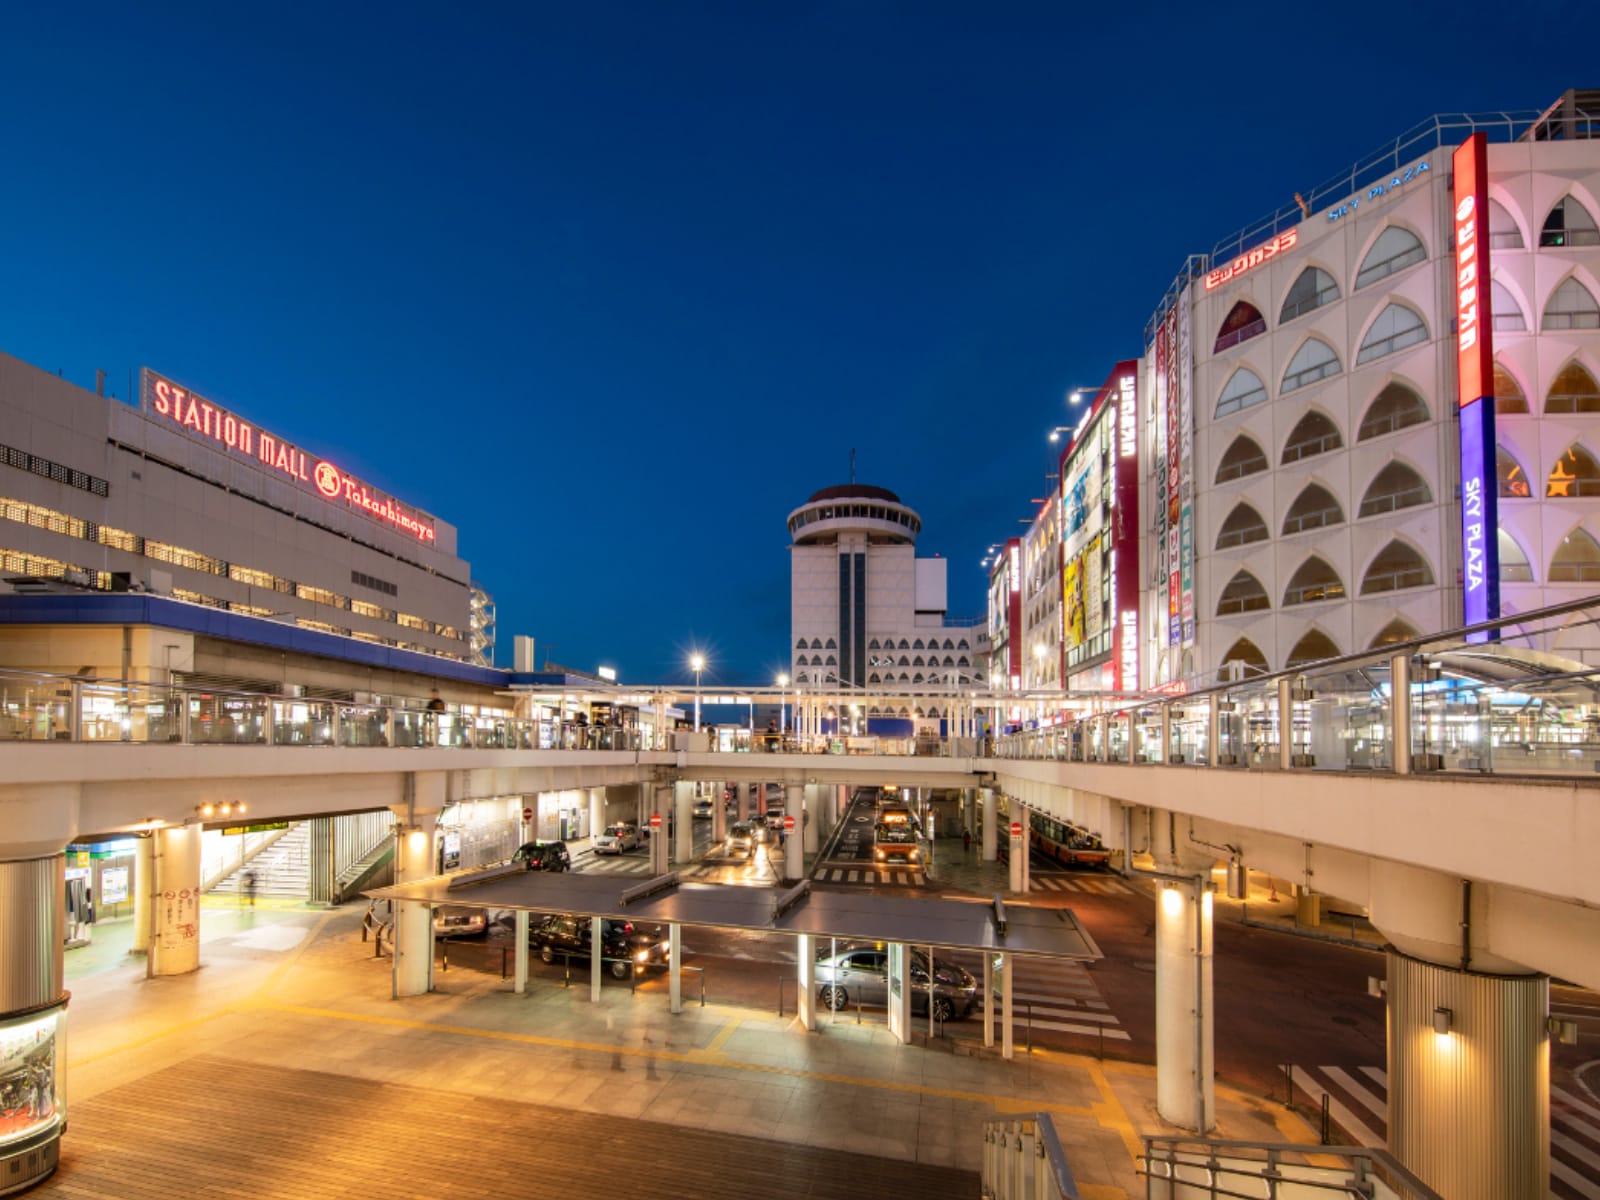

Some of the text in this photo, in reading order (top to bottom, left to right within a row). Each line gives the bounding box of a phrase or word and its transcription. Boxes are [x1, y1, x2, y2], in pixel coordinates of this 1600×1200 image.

[1327, 161, 1430, 223] SKY PLAZA
[1205, 228, 1297, 290] ビックカメラ
[154, 380, 308, 481] STATION MALL
[341, 477, 434, 540] Takashimaya
[1465, 477, 1483, 592] SKY PLAZA
